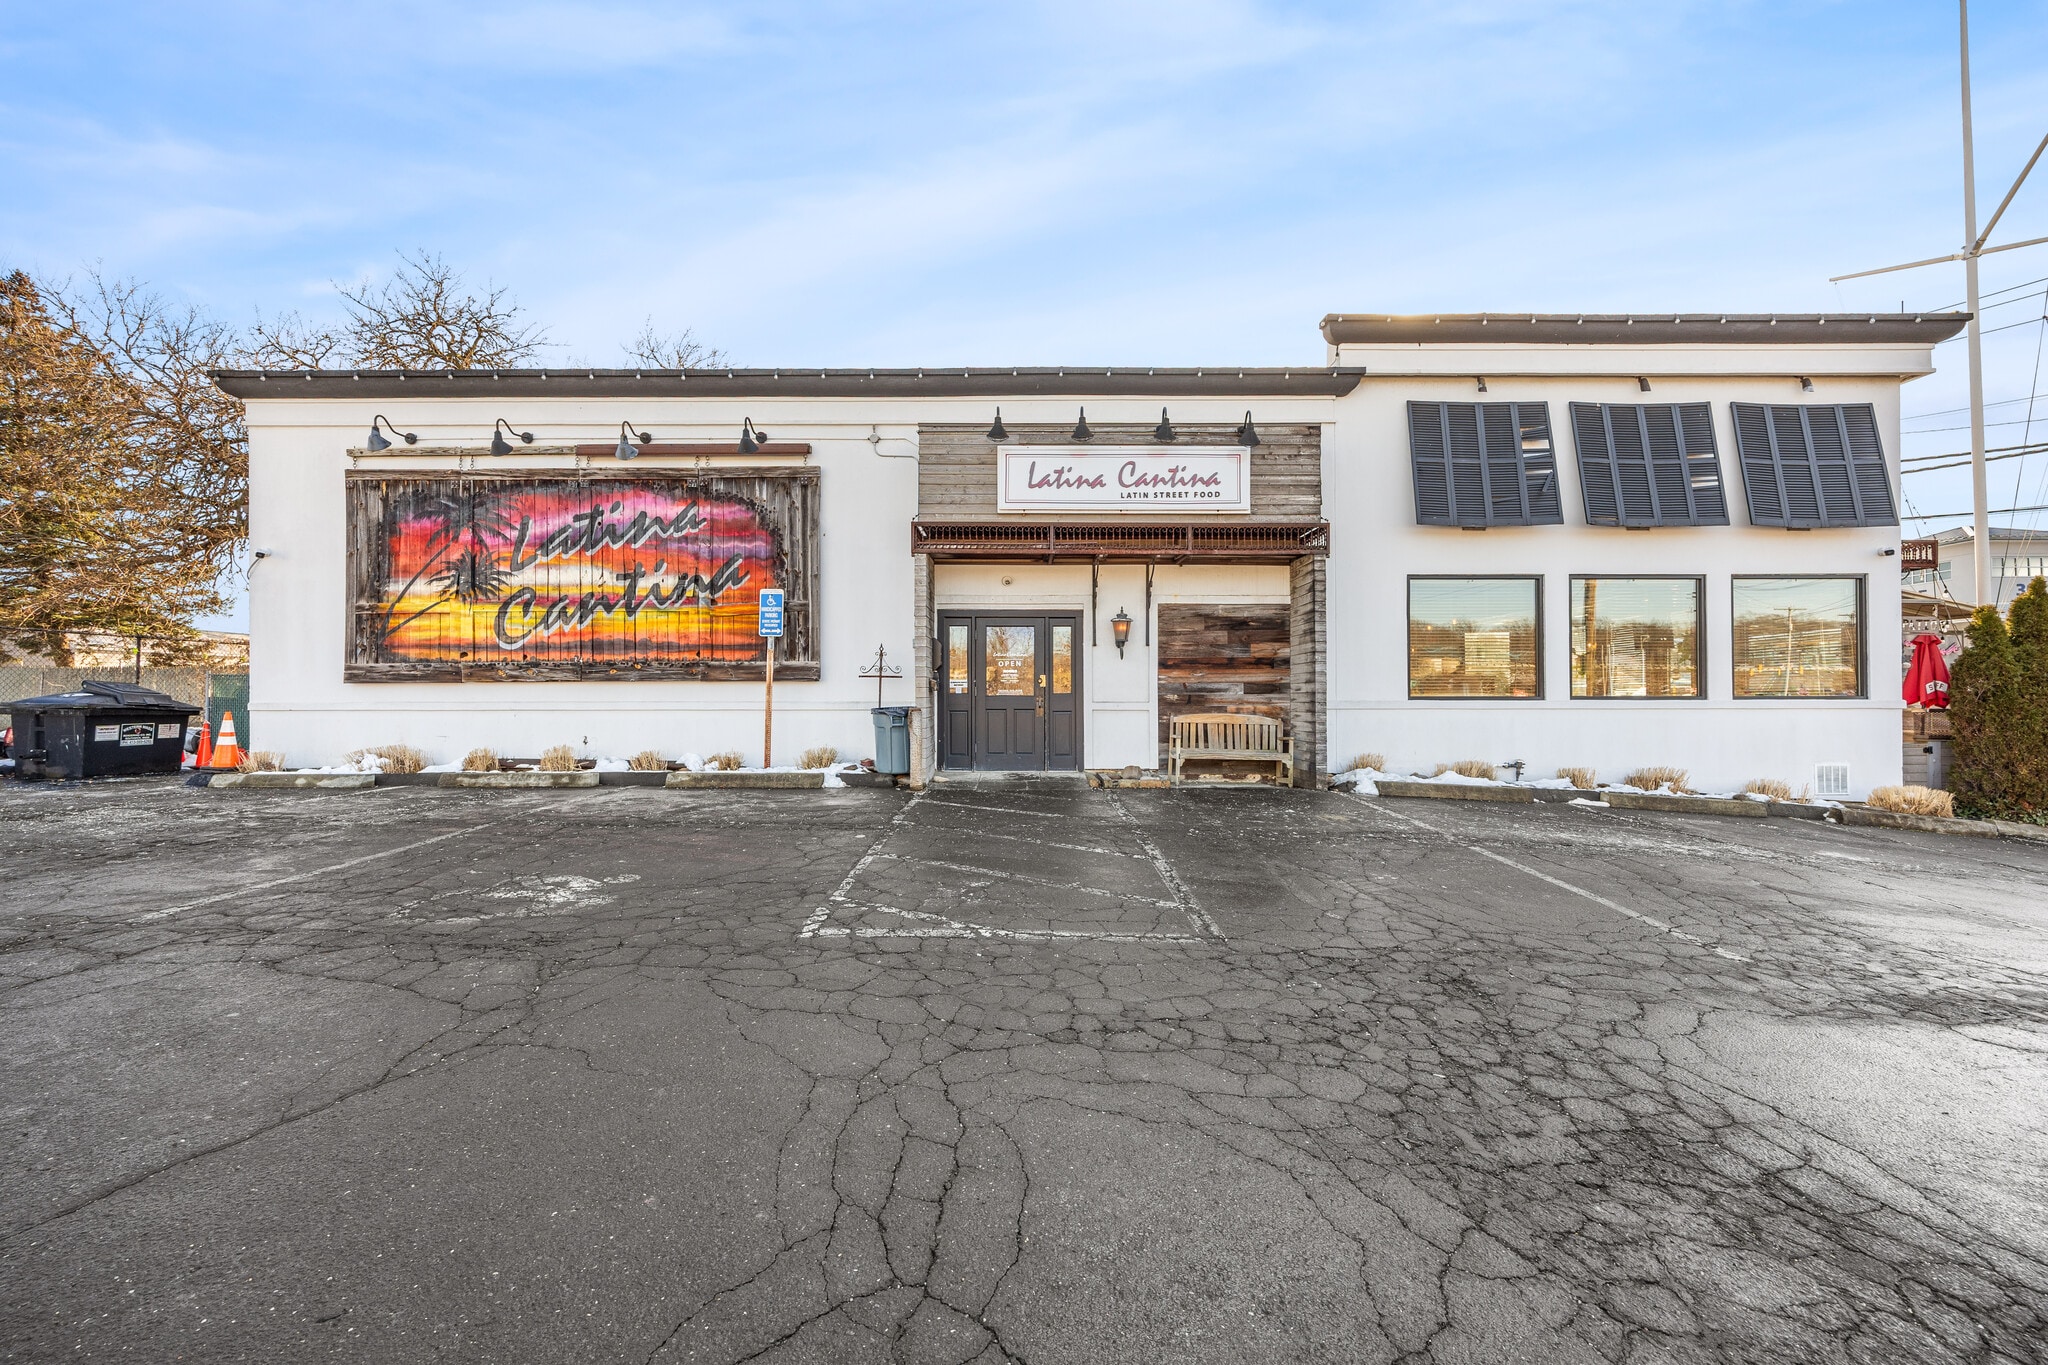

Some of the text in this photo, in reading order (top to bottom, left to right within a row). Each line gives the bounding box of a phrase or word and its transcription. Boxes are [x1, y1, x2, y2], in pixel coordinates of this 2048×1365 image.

[1028, 460, 1221, 489] Latina Cantina
[1153, 491, 1189, 499] STREET
[509, 500, 707, 574] Latina
[493, 552, 751, 650] Cantina
